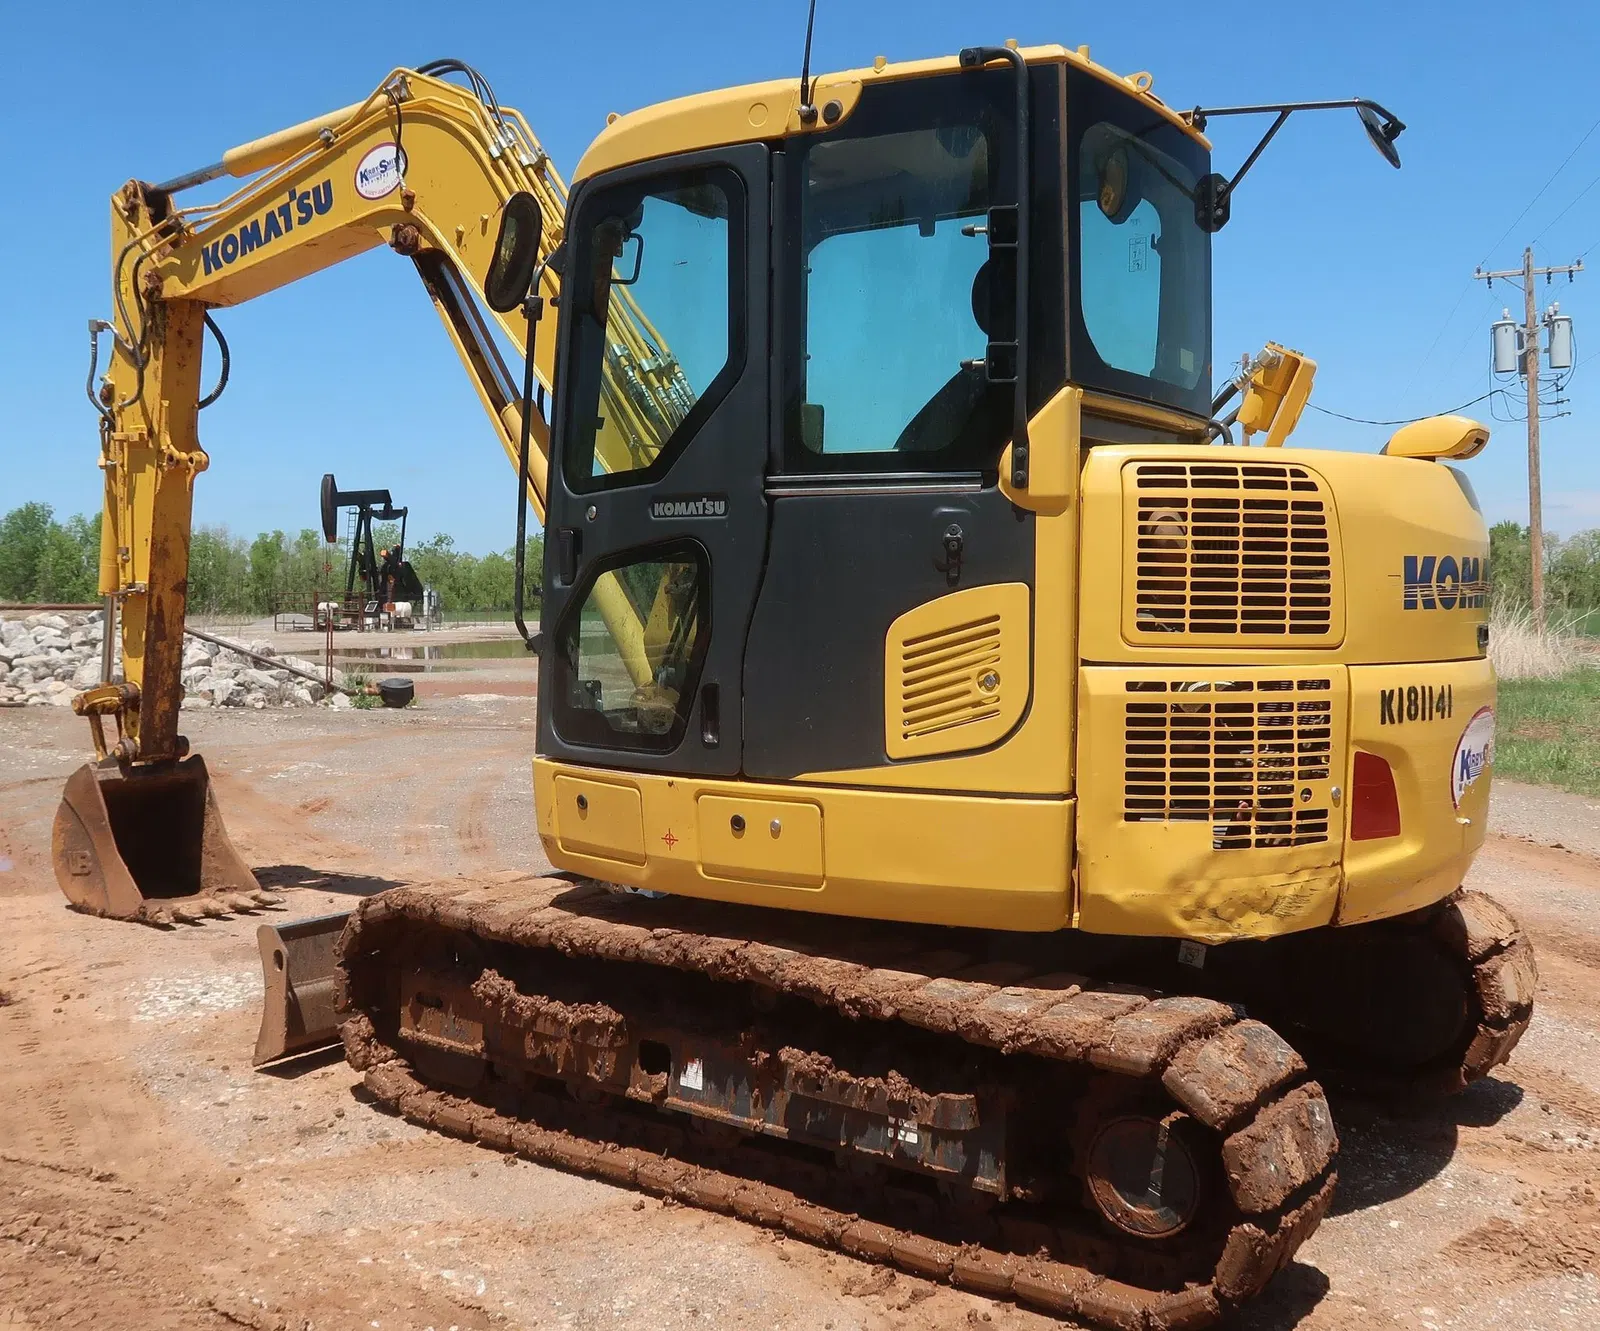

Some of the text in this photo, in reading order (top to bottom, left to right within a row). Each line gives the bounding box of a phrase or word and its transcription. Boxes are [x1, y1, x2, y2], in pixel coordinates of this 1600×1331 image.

[201, 179, 334, 276] KOMATSU
[654, 497, 725, 516] KOMATSU
[1380, 684, 1452, 725] K181141
